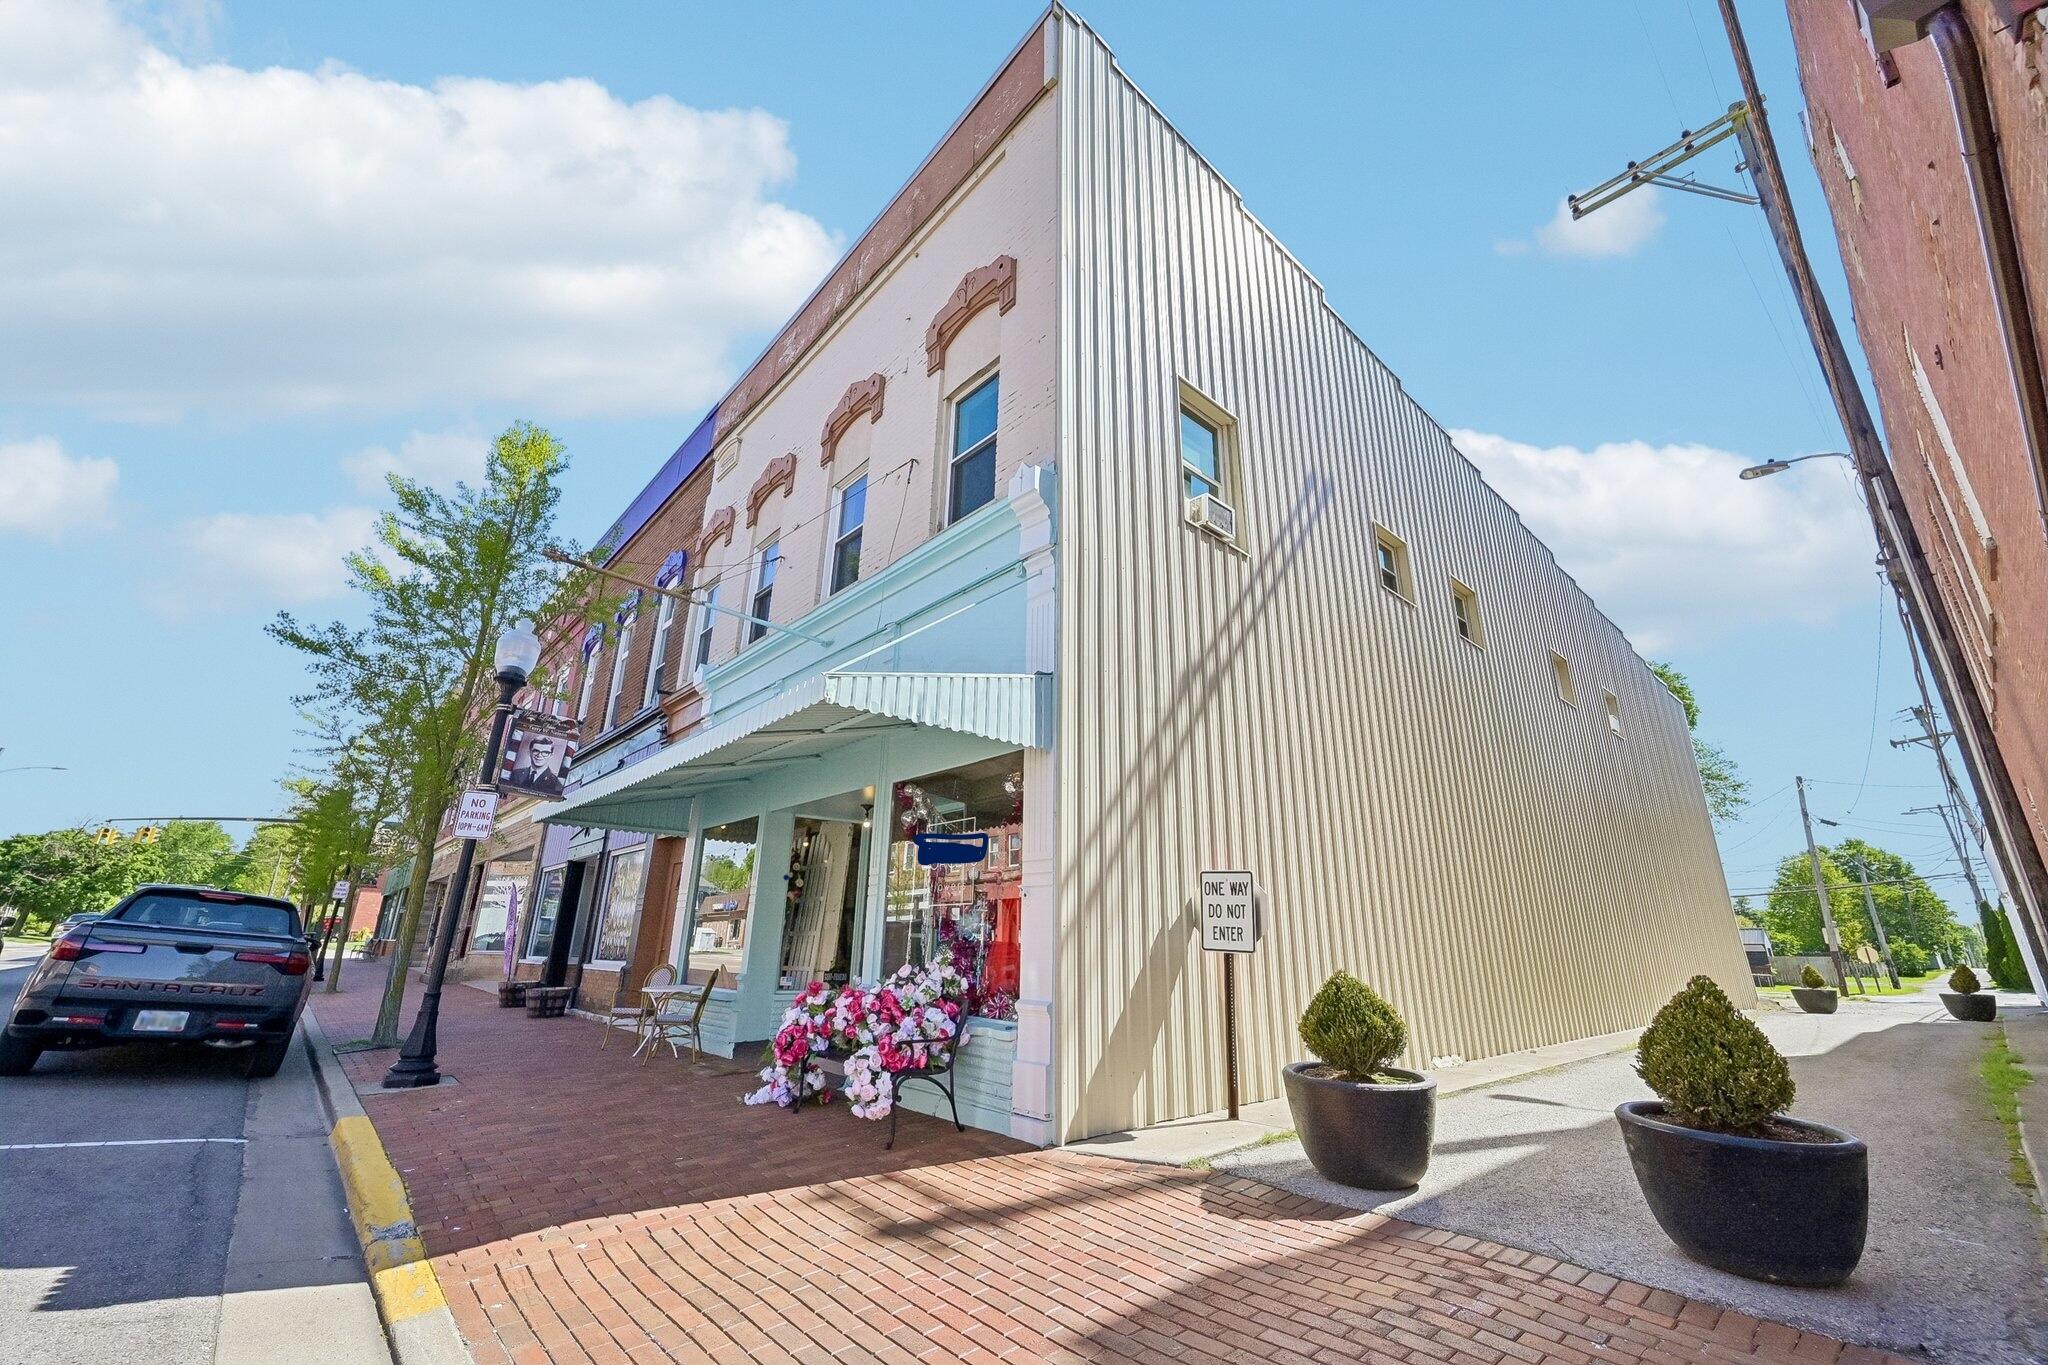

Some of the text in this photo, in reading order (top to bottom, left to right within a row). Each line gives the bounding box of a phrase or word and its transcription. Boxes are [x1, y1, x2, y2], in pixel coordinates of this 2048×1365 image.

[470, 798, 487, 808] NO
[460, 810, 491, 821] PARKING
[1204, 881, 1249, 896] ONE WAY
[1208, 903, 1246, 919] DO NOT
[1213, 926, 1243, 942] ENTER
[78, 978, 265, 997] SANTA CRUZ
